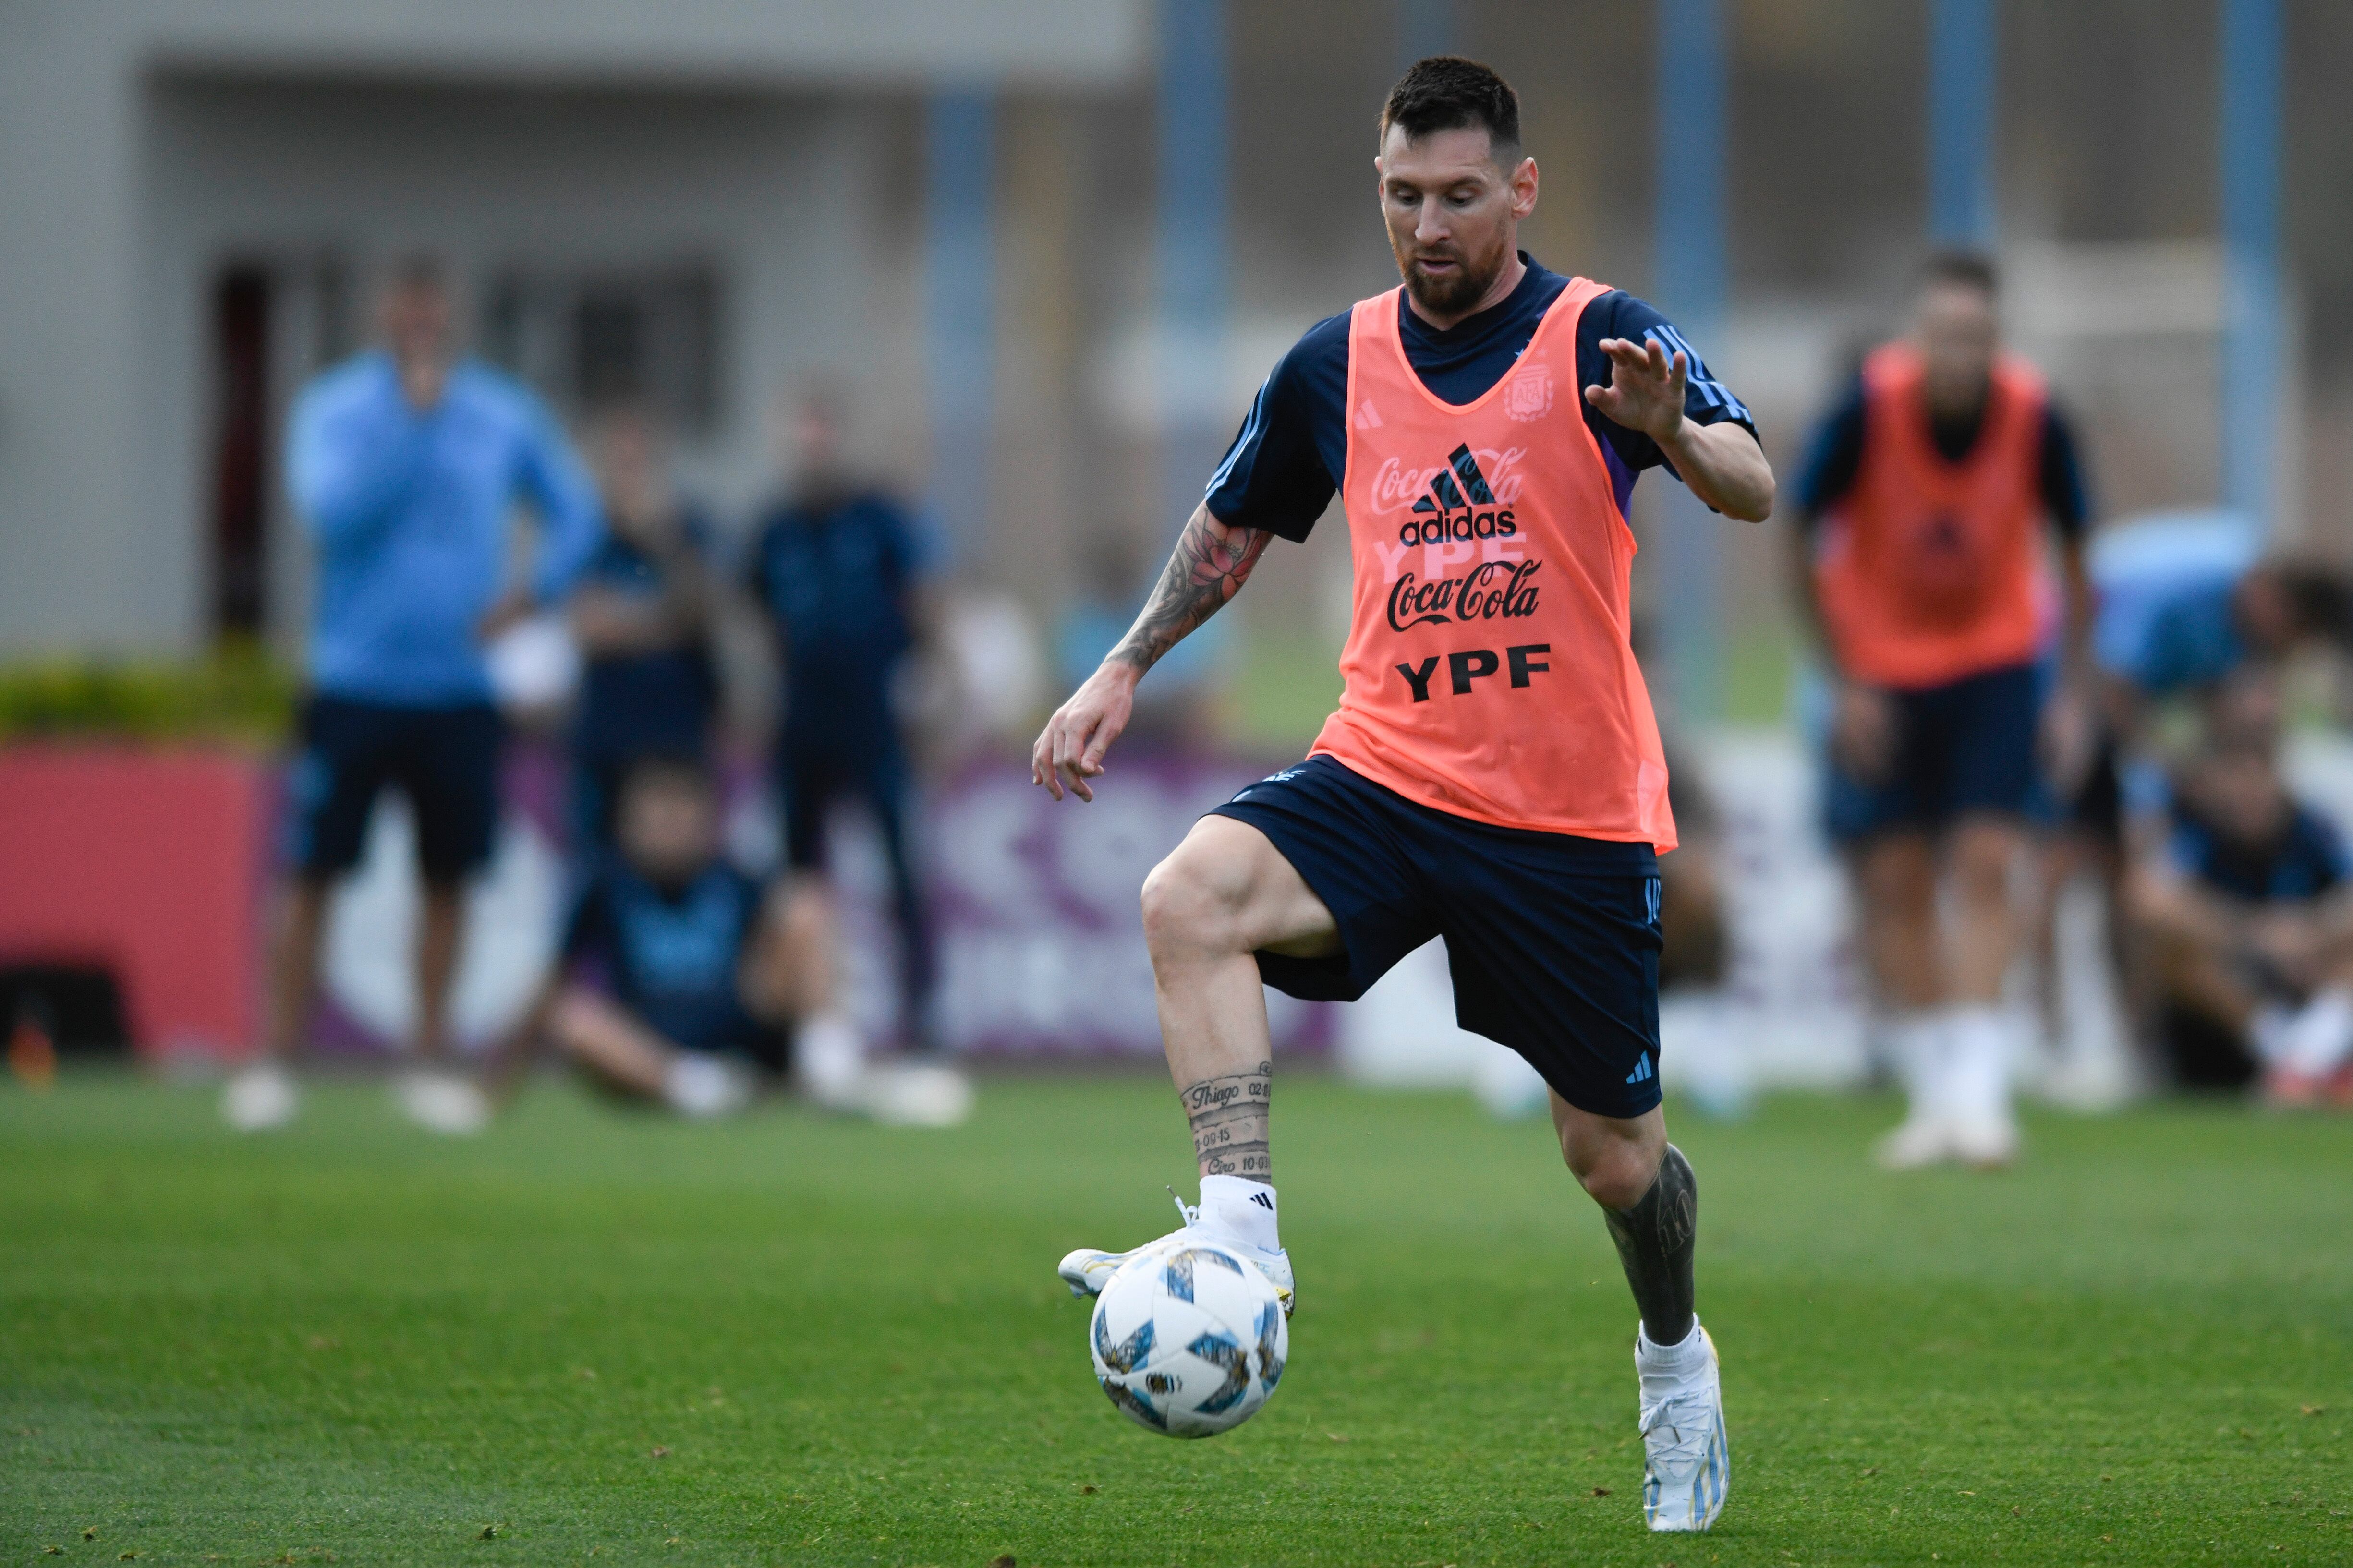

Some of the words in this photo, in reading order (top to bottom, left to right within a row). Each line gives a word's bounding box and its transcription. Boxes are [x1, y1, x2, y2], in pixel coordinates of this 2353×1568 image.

[1399, 506, 1516, 547] adidas
[1372, 532, 1527, 584] YPF
[1387, 559, 1542, 632] Coca-Cola
[1395, 644, 1551, 703] YPF
[1192, 1086, 1239, 1109] Thiago
[1208, 1158, 1235, 1175] Ciro
